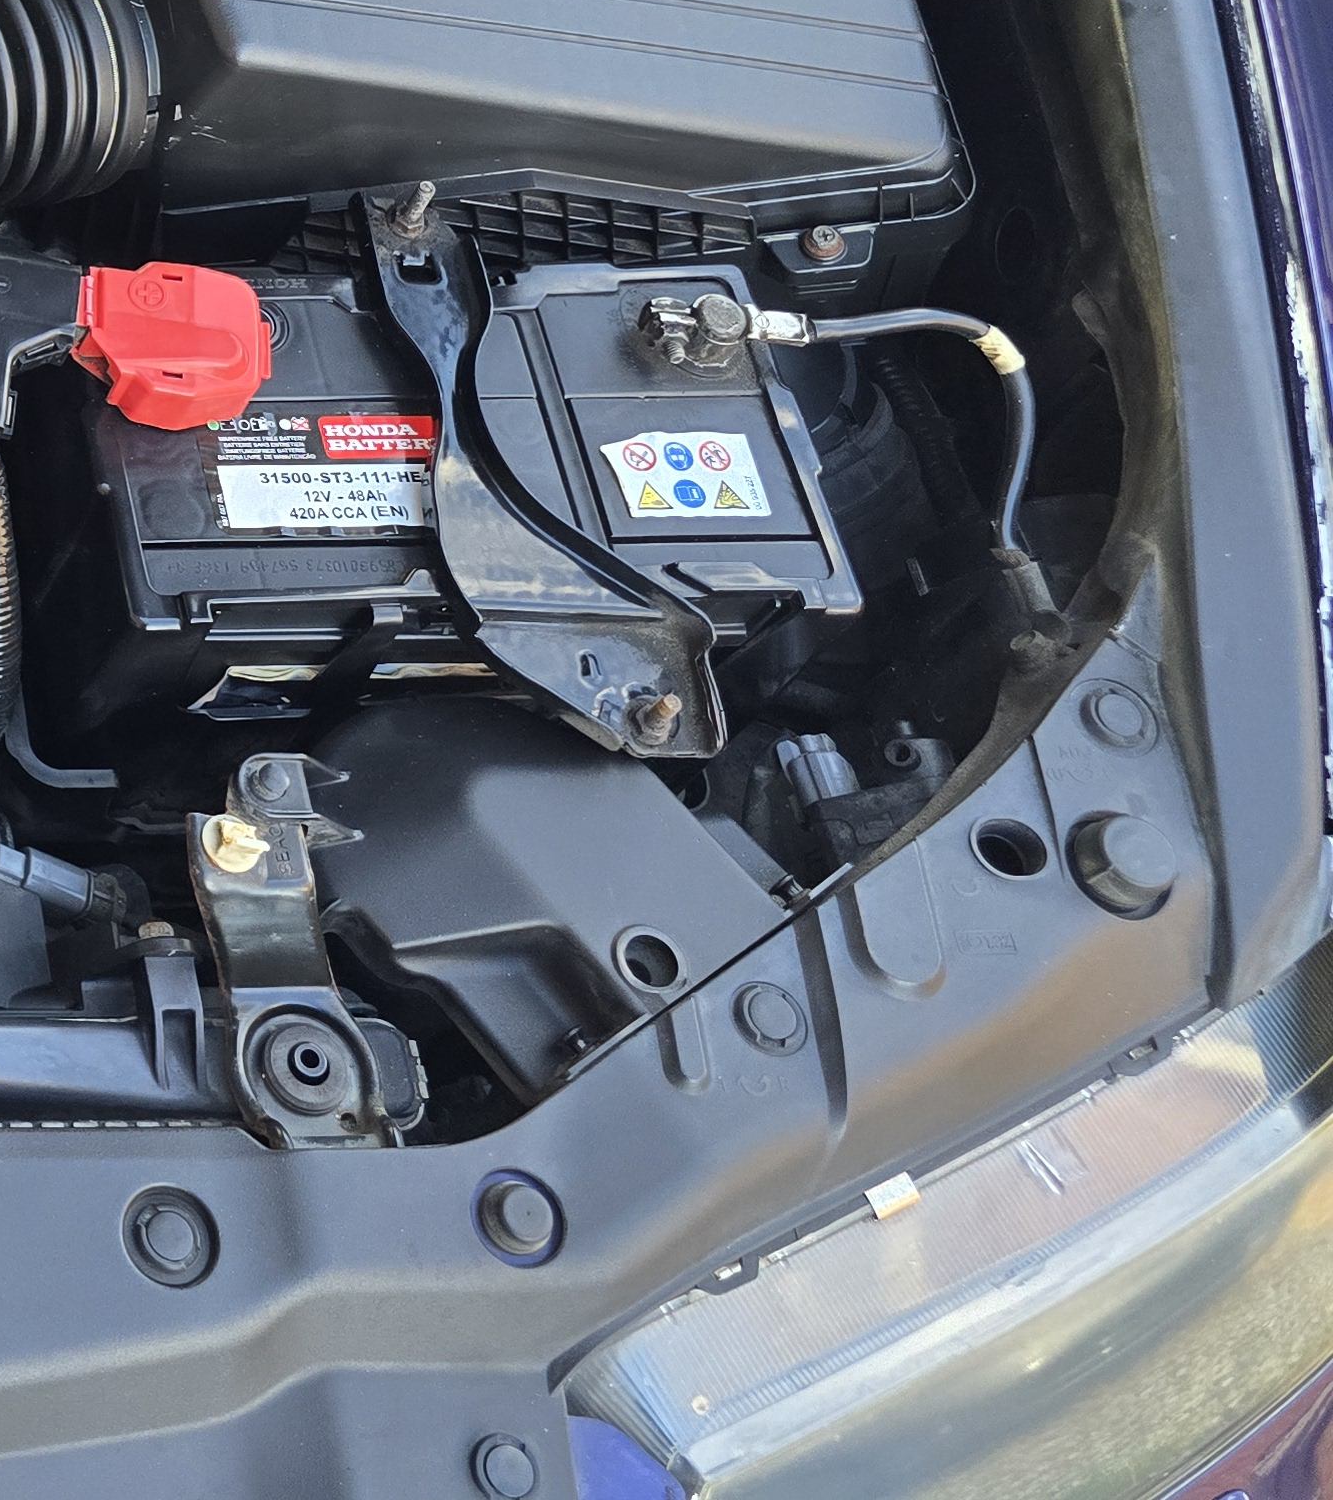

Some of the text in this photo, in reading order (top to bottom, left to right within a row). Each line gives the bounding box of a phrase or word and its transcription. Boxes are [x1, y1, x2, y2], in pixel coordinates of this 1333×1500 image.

[323, 424, 418, 437] HONDA
[327, 438, 435, 451] BATTER
[259, 471, 422, 485] 31500-ST3-111-HE
[304, 490, 331, 502] 12V
[348, 489, 387, 502] 48Ah
[290, 505, 409, 520] 420A CCA (EN)
